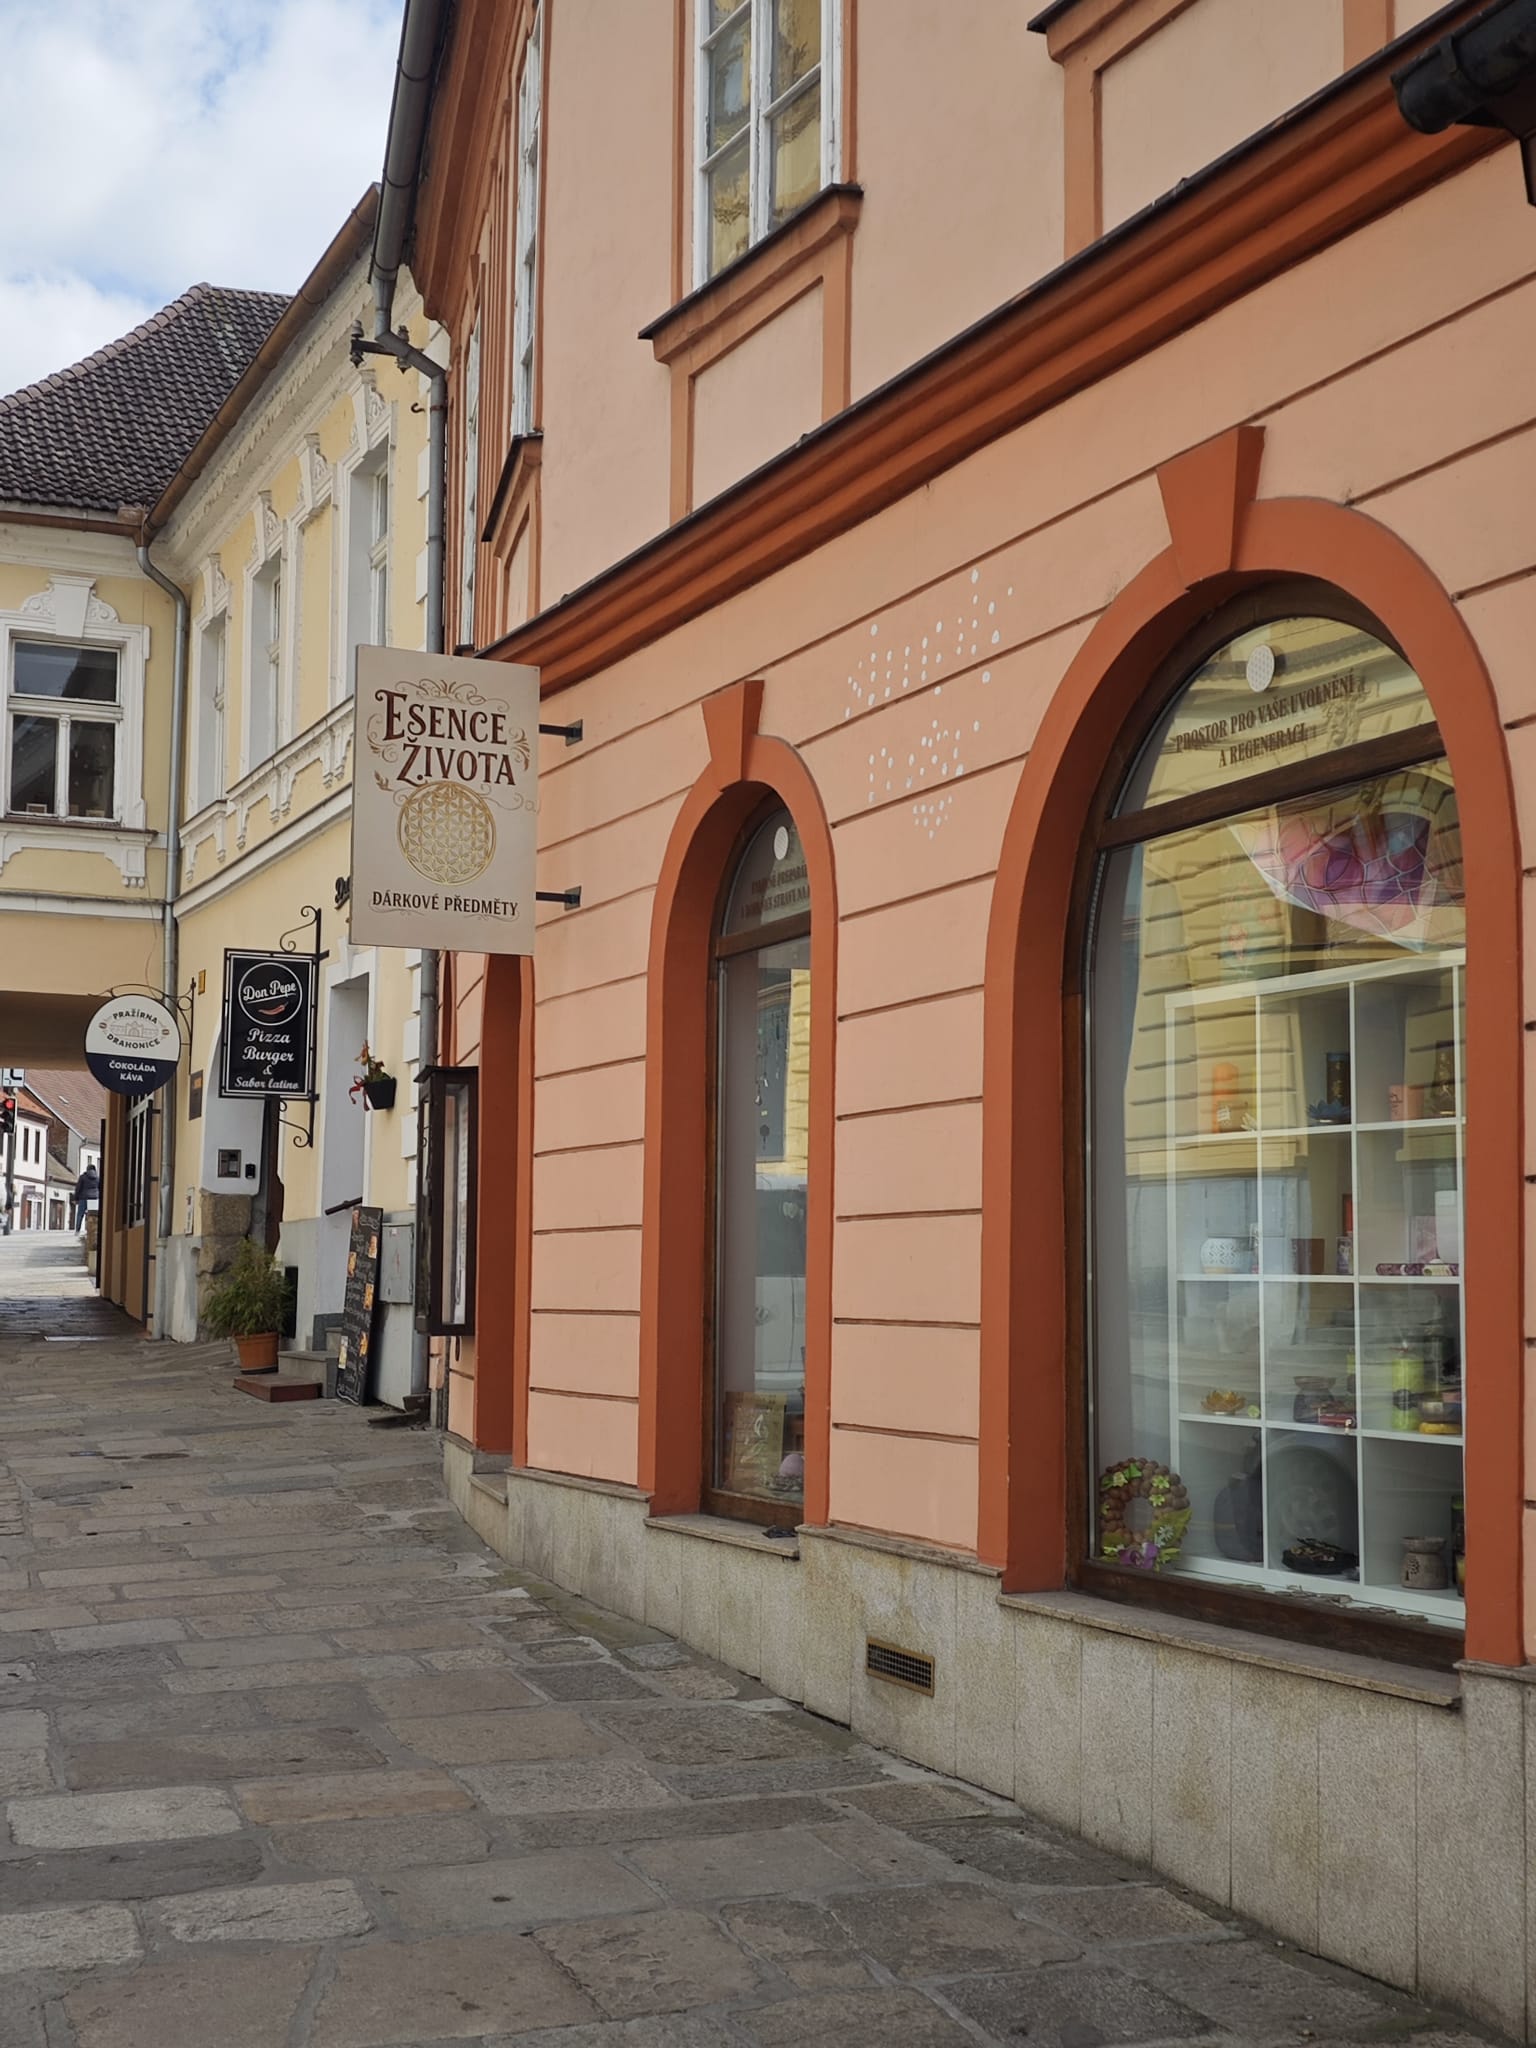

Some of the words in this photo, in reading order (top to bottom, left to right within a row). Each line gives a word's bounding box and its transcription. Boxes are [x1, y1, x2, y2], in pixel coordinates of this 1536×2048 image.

[375, 689, 508, 745] ESENCE
[1176, 723, 1227, 753] PROSTOR
[1231, 710, 1255, 735] PRO
[1258, 698, 1288, 725] VAŠE
[1289, 668, 1356, 713] UVOLNĚNÍ
[1218, 749, 1227, 769] A
[1230, 722, 1307, 765] REGENERACI
[396, 735, 516, 787] ŽIVOTA
[372, 890, 439, 911] DÁRKOVÉ
[444, 894, 518, 917] PŘEDMĚTY
[242, 985, 268, 1002] Don
[269, 979, 297, 998] Pepe
[112, 1008, 158, 1024] PRAŽÍRNA
[106, 1033, 161, 1049] DRAHONICE
[247, 1027, 292, 1044] Pizza
[242, 1046, 295, 1065] Burger
[109, 1060, 157, 1073] ČOKOLÁDA
[262, 1064, 273, 1076] &
[120, 1072, 144, 1083] KÁVA
[235, 1076, 266, 1089] Sabor
